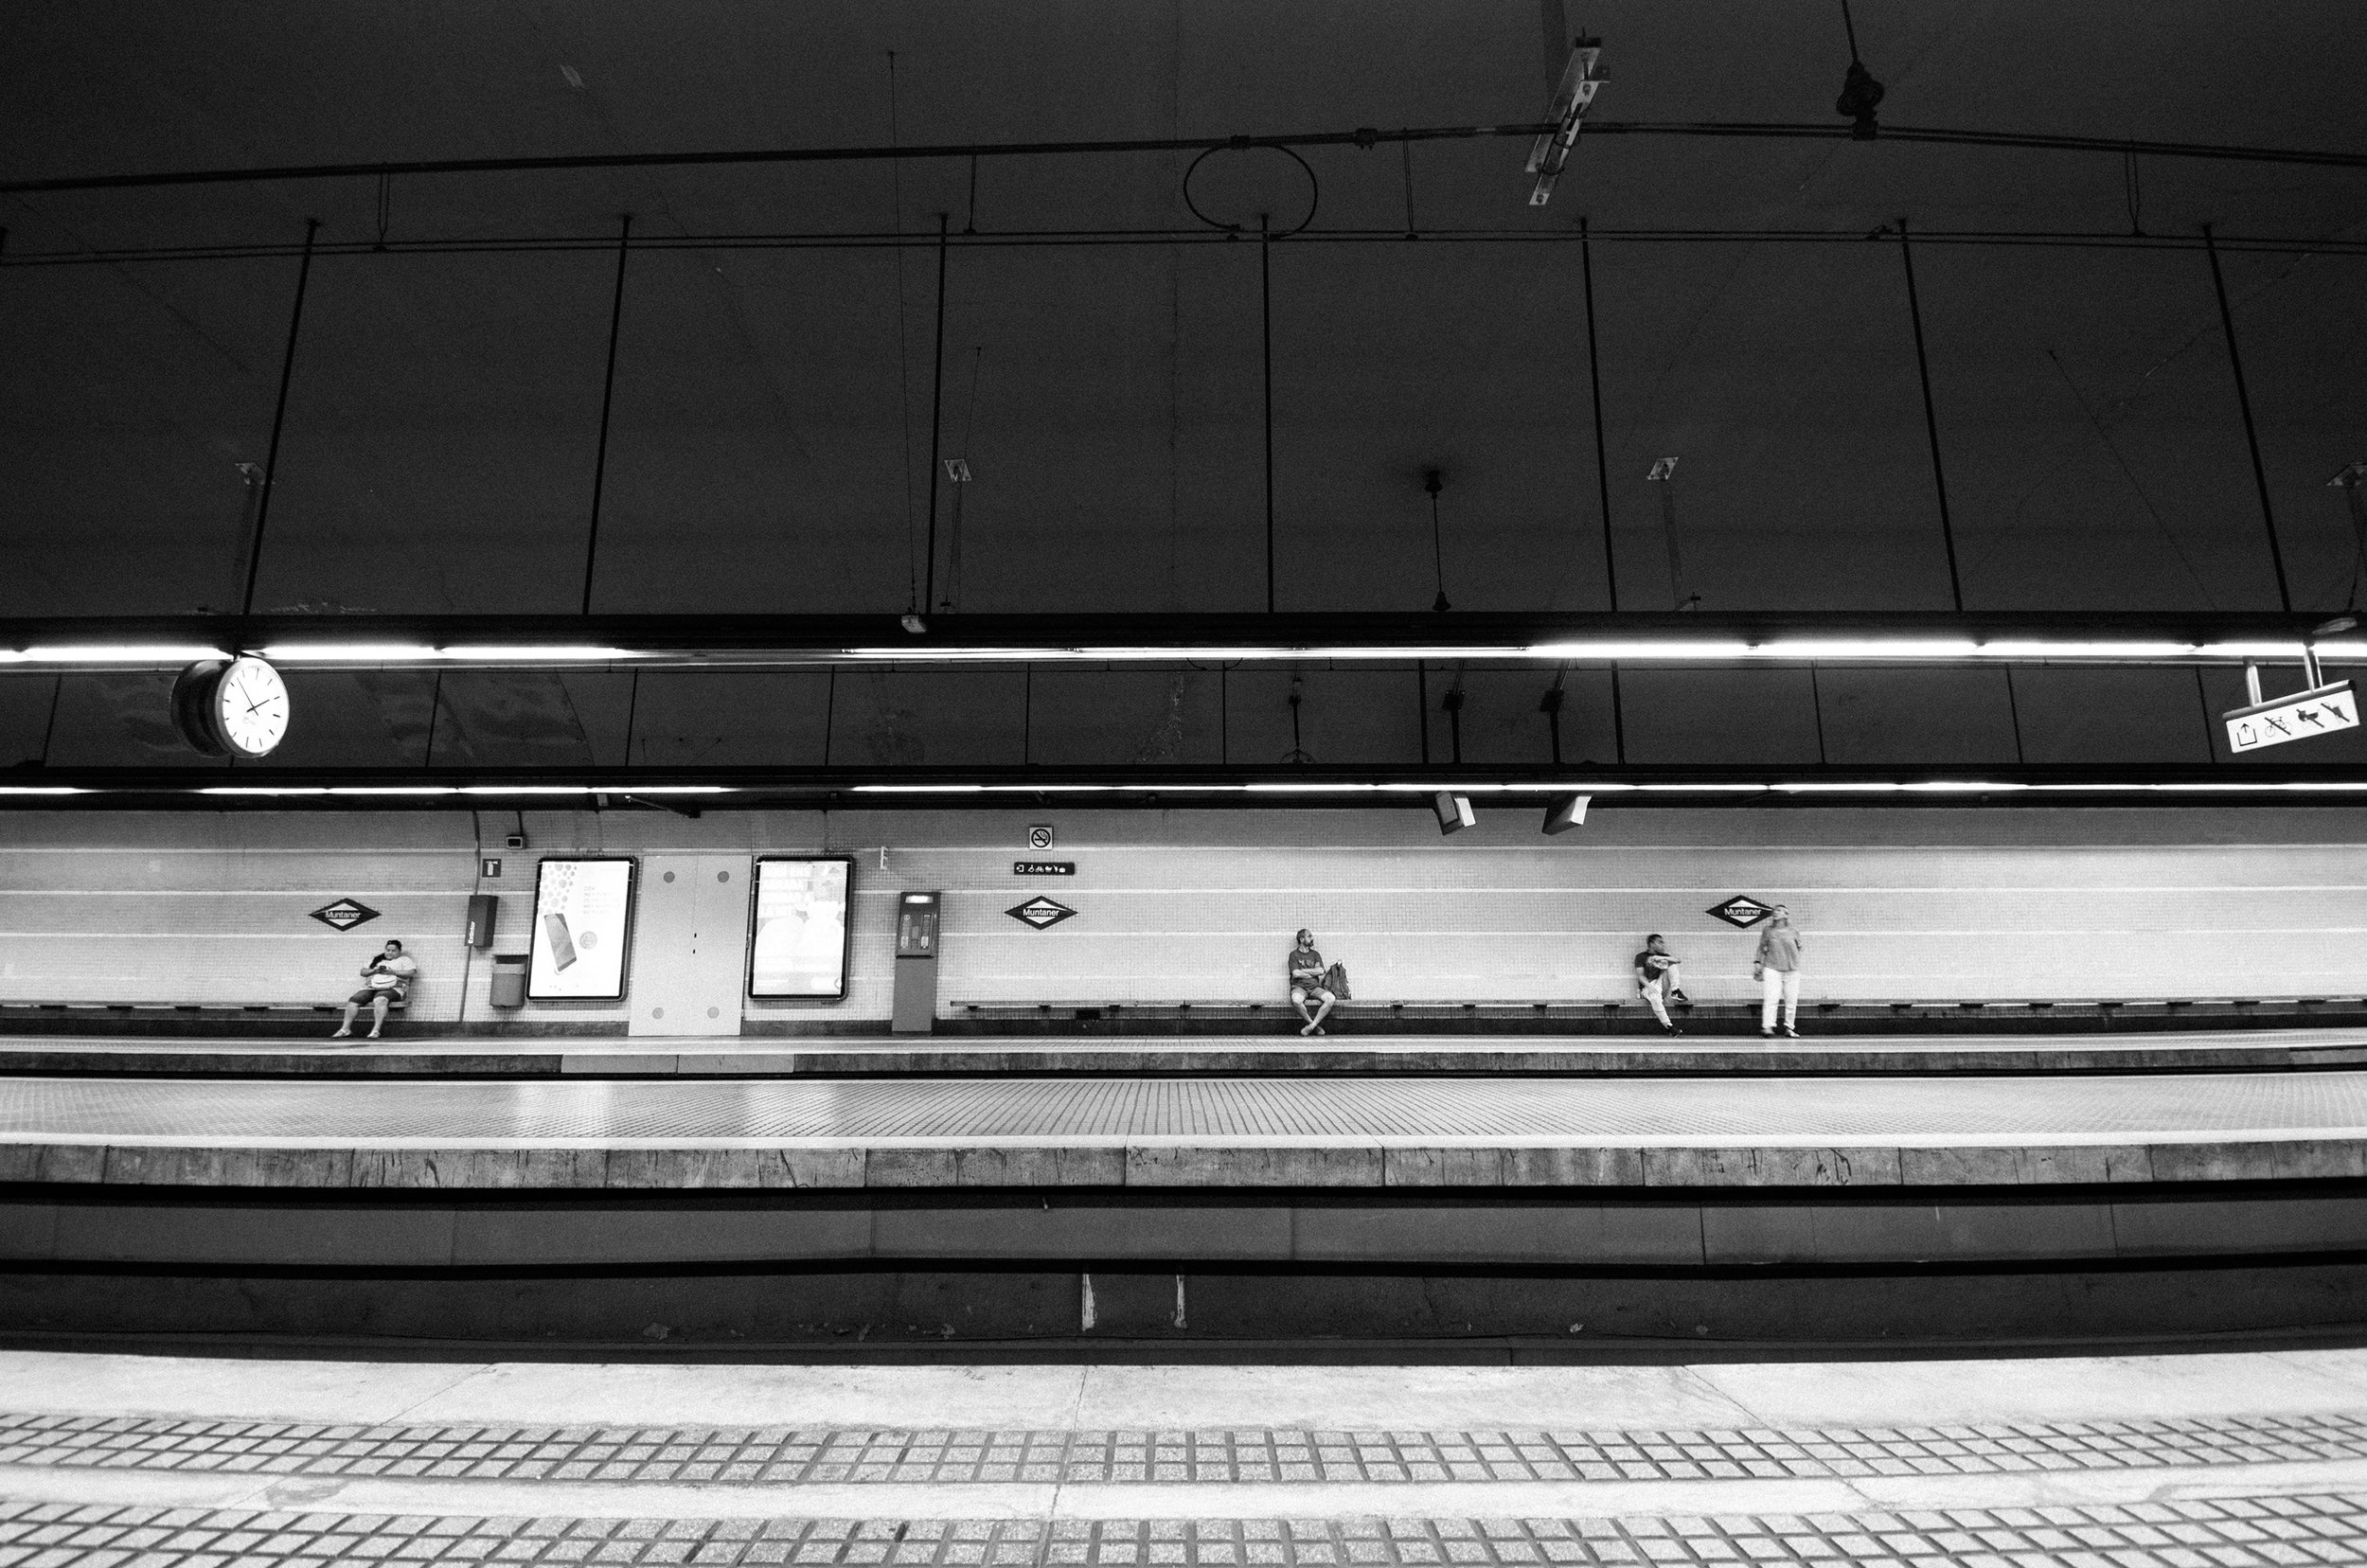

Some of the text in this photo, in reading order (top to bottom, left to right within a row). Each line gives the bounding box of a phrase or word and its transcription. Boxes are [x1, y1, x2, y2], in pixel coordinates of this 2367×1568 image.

[325, 910, 362, 918] Muntaner
[1023, 908, 1060, 917] Muntaner
[1724, 907, 1762, 916] Muntaner
